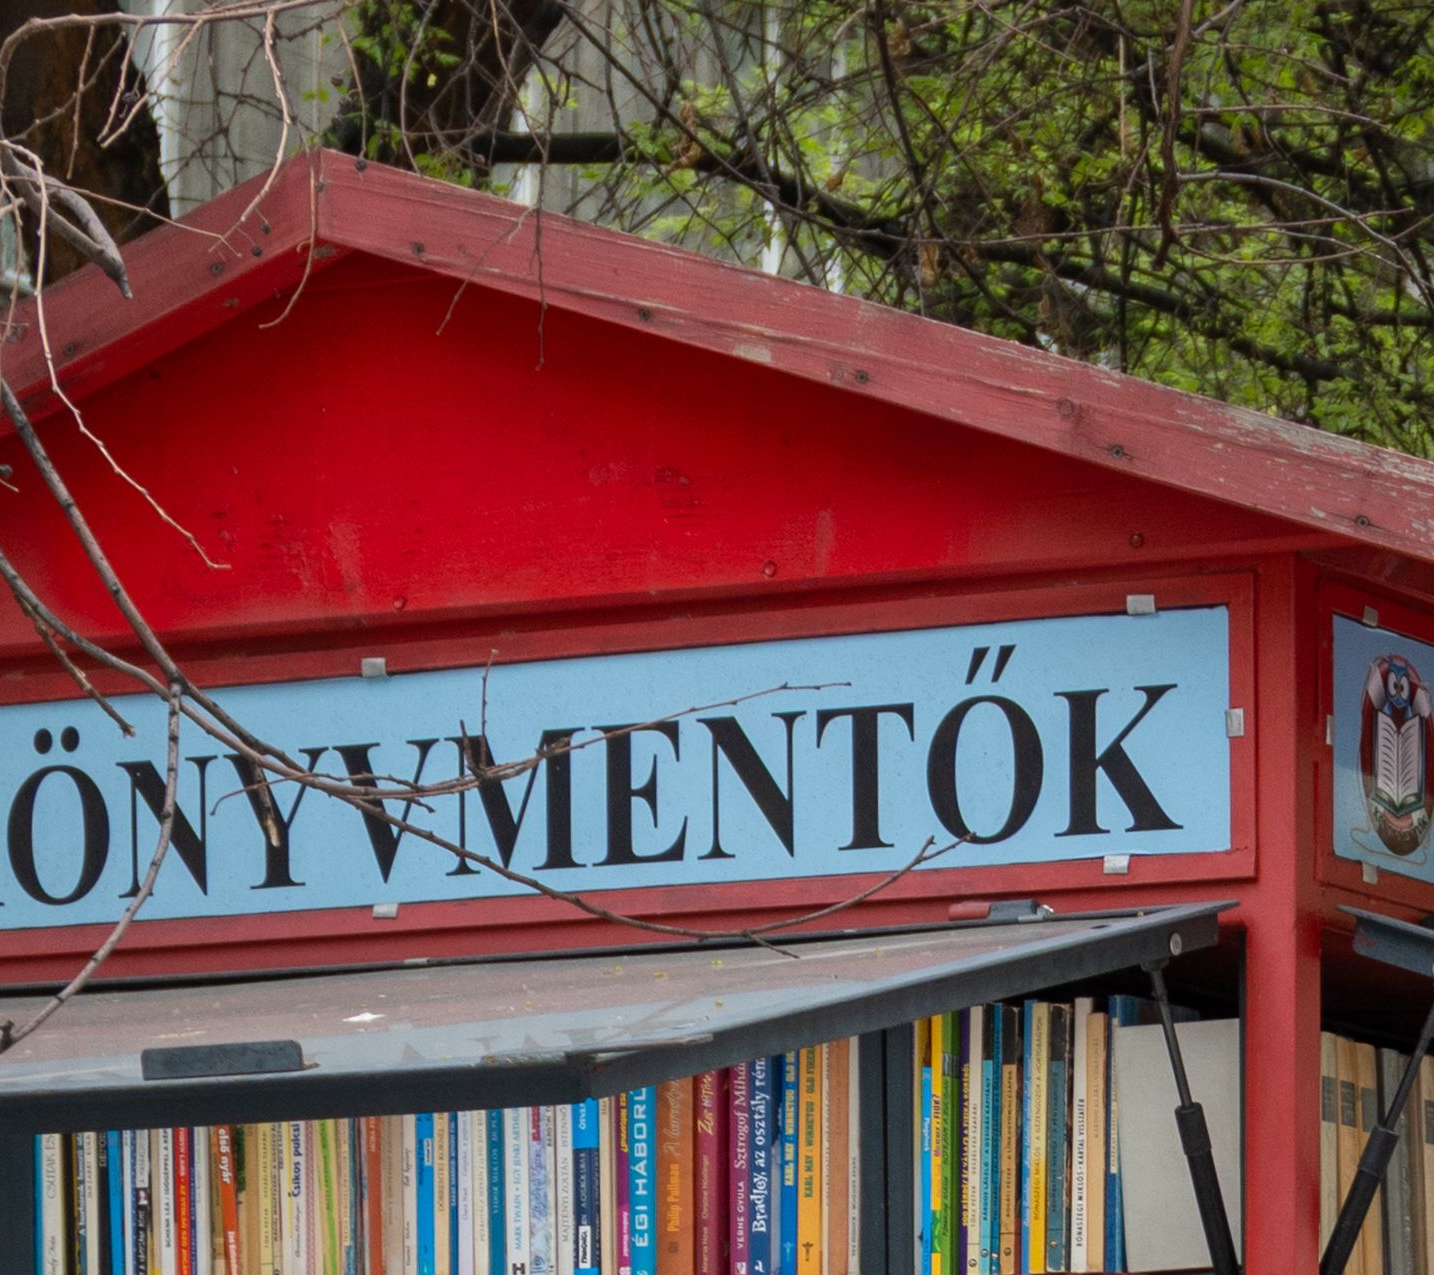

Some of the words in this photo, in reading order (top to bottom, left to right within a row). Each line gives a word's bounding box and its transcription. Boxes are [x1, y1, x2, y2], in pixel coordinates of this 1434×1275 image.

[750, 1091, 769, 1145] osztály
[734, 1109, 748, 1169] Sztrogof
[754, 1150, 765, 1167] az
[736, 1181, 744, 1213] GYULA
[750, 1171, 767, 1232] Bradley,
[632, 1206, 648, 1247] ÉGI
[736, 1216, 744, 1249] VERNE
